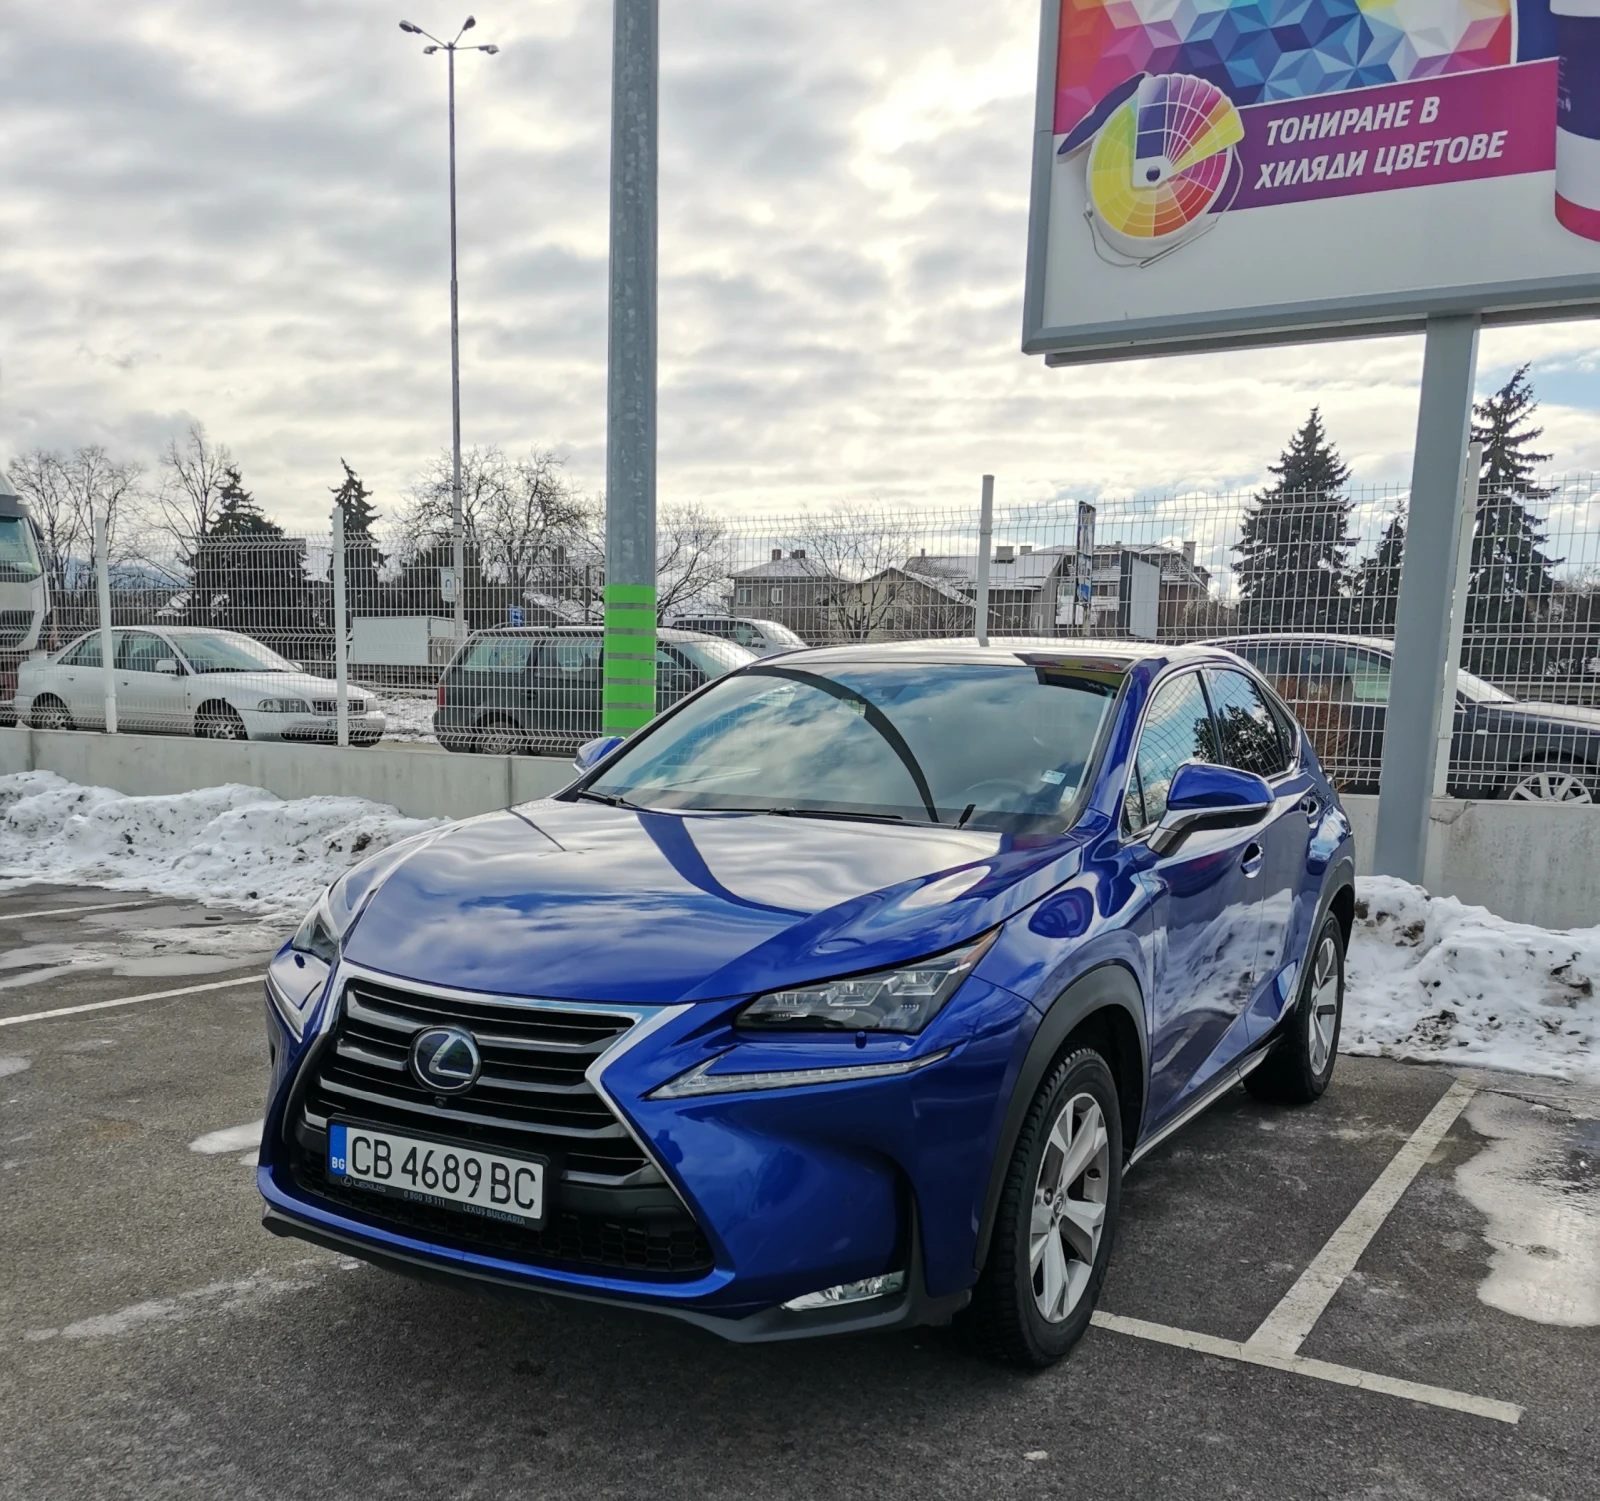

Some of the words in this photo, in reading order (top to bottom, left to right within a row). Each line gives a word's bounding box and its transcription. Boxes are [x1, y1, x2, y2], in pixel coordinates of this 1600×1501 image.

[1266, 99, 1414, 146] ТОНИРАНЕ
[1419, 96, 1441, 125] В
[1254, 149, 1369, 190] ХИЛЯДИ
[1373, 130, 1509, 175] ЦВЕТОВЕ
[331, 1156, 345, 1171] BG
[400, 1146, 482, 1199] 4689
[353, 1180, 387, 1193] LEXUS
[462, 1203, 486, 1216] LEXUS
[486, 1209, 526, 1226] BULGARIA
